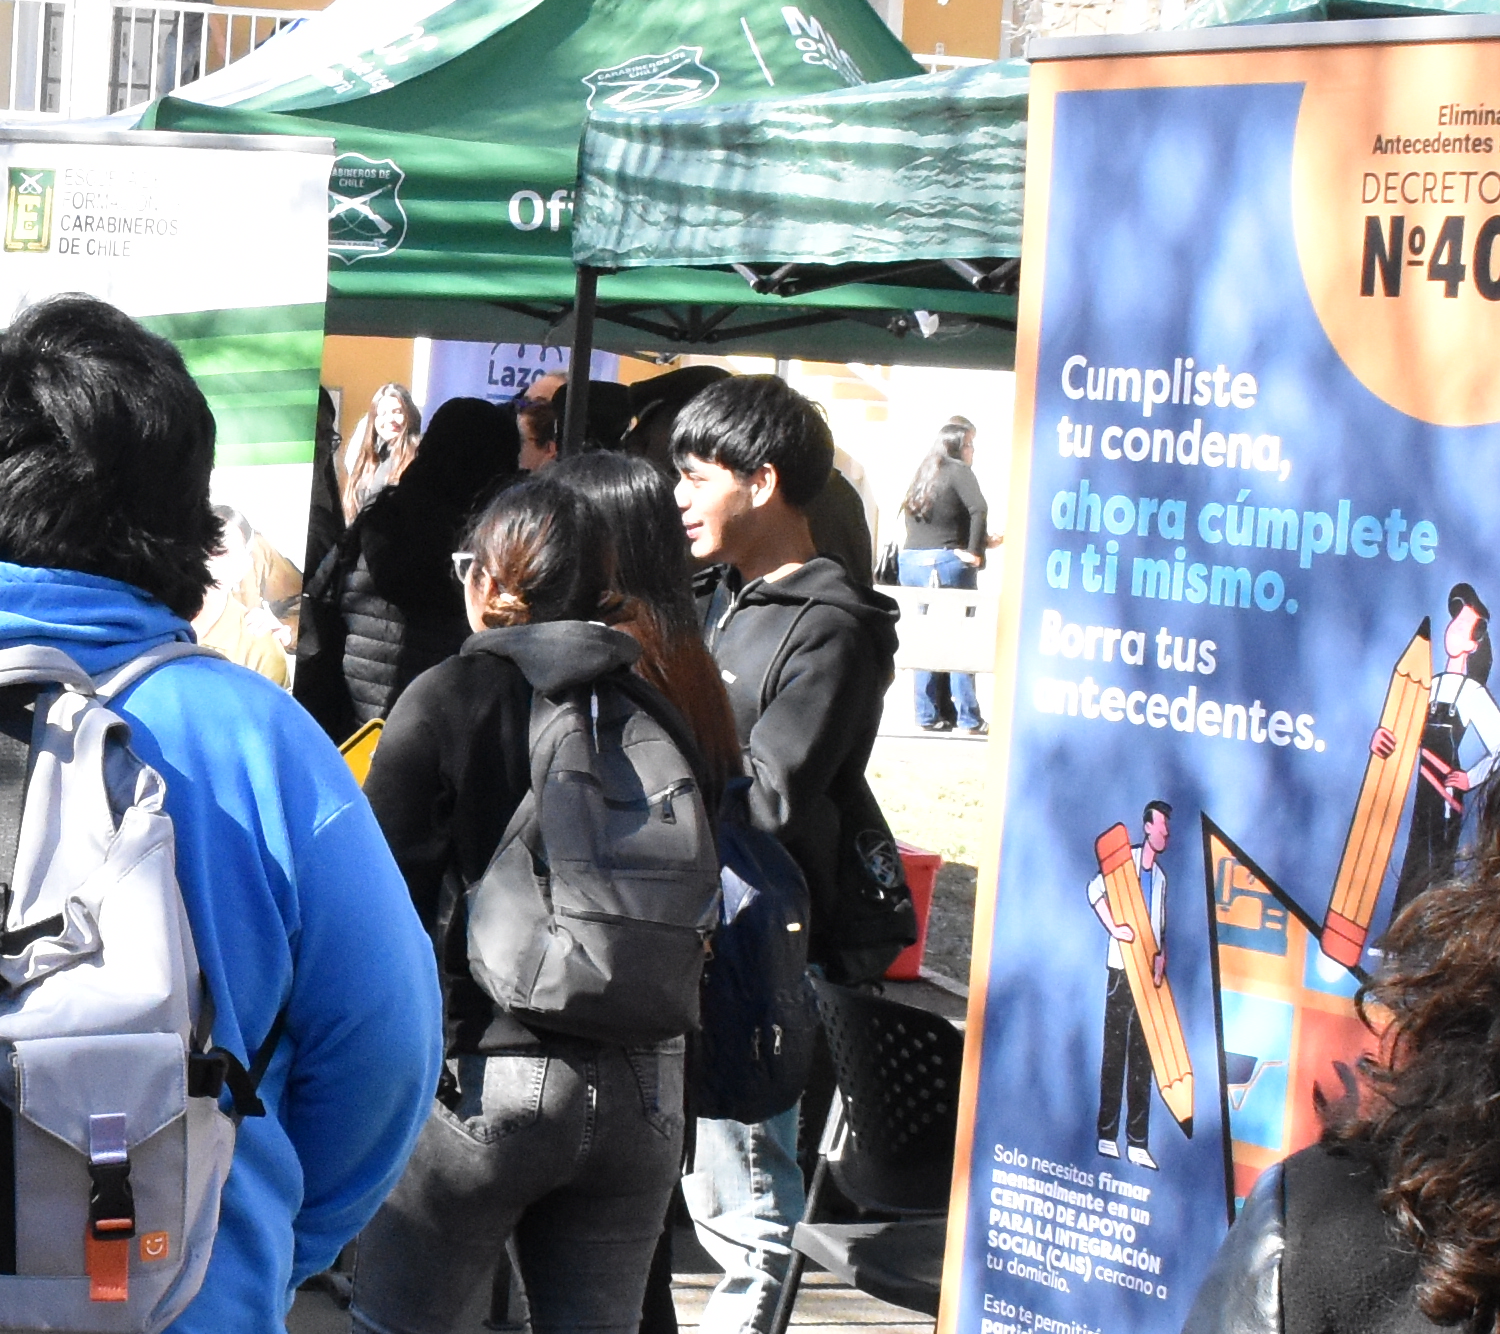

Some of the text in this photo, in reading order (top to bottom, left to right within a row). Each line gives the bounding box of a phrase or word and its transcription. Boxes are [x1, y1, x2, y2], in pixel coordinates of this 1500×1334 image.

[1372, 132, 1493, 154] Antecedentes
[59, 237, 131, 257] DE CHILE
[60, 215, 178, 236] CARABINEROS
[1061, 354, 1258, 417] Cumpliste
[1057, 416, 1291, 481] tu condena,
[1051, 480, 1438, 568] ahora cúmplete
[1047, 540, 1298, 614] a ti mismo.
[1039, 609, 1217, 674] Borra tus
[1033, 677, 1326, 752] antecedentes.
[992, 1169, 1150, 1226] mensualmente en un
[994, 1144, 1151, 1202] Solo necesitas firmar
[990, 1208, 1162, 1274] PARA LA INTEGRACIÓN
[991, 1187, 1136, 1243] CENTRO DE APOYO
[987, 1252, 1070, 1293] tu domicilio.
[988, 1230, 1167, 1299] SOCIAL (CAIS) cercano a
[984, 1294, 1016, 1318] Esto
[1018, 1305, 1032, 1324] te
